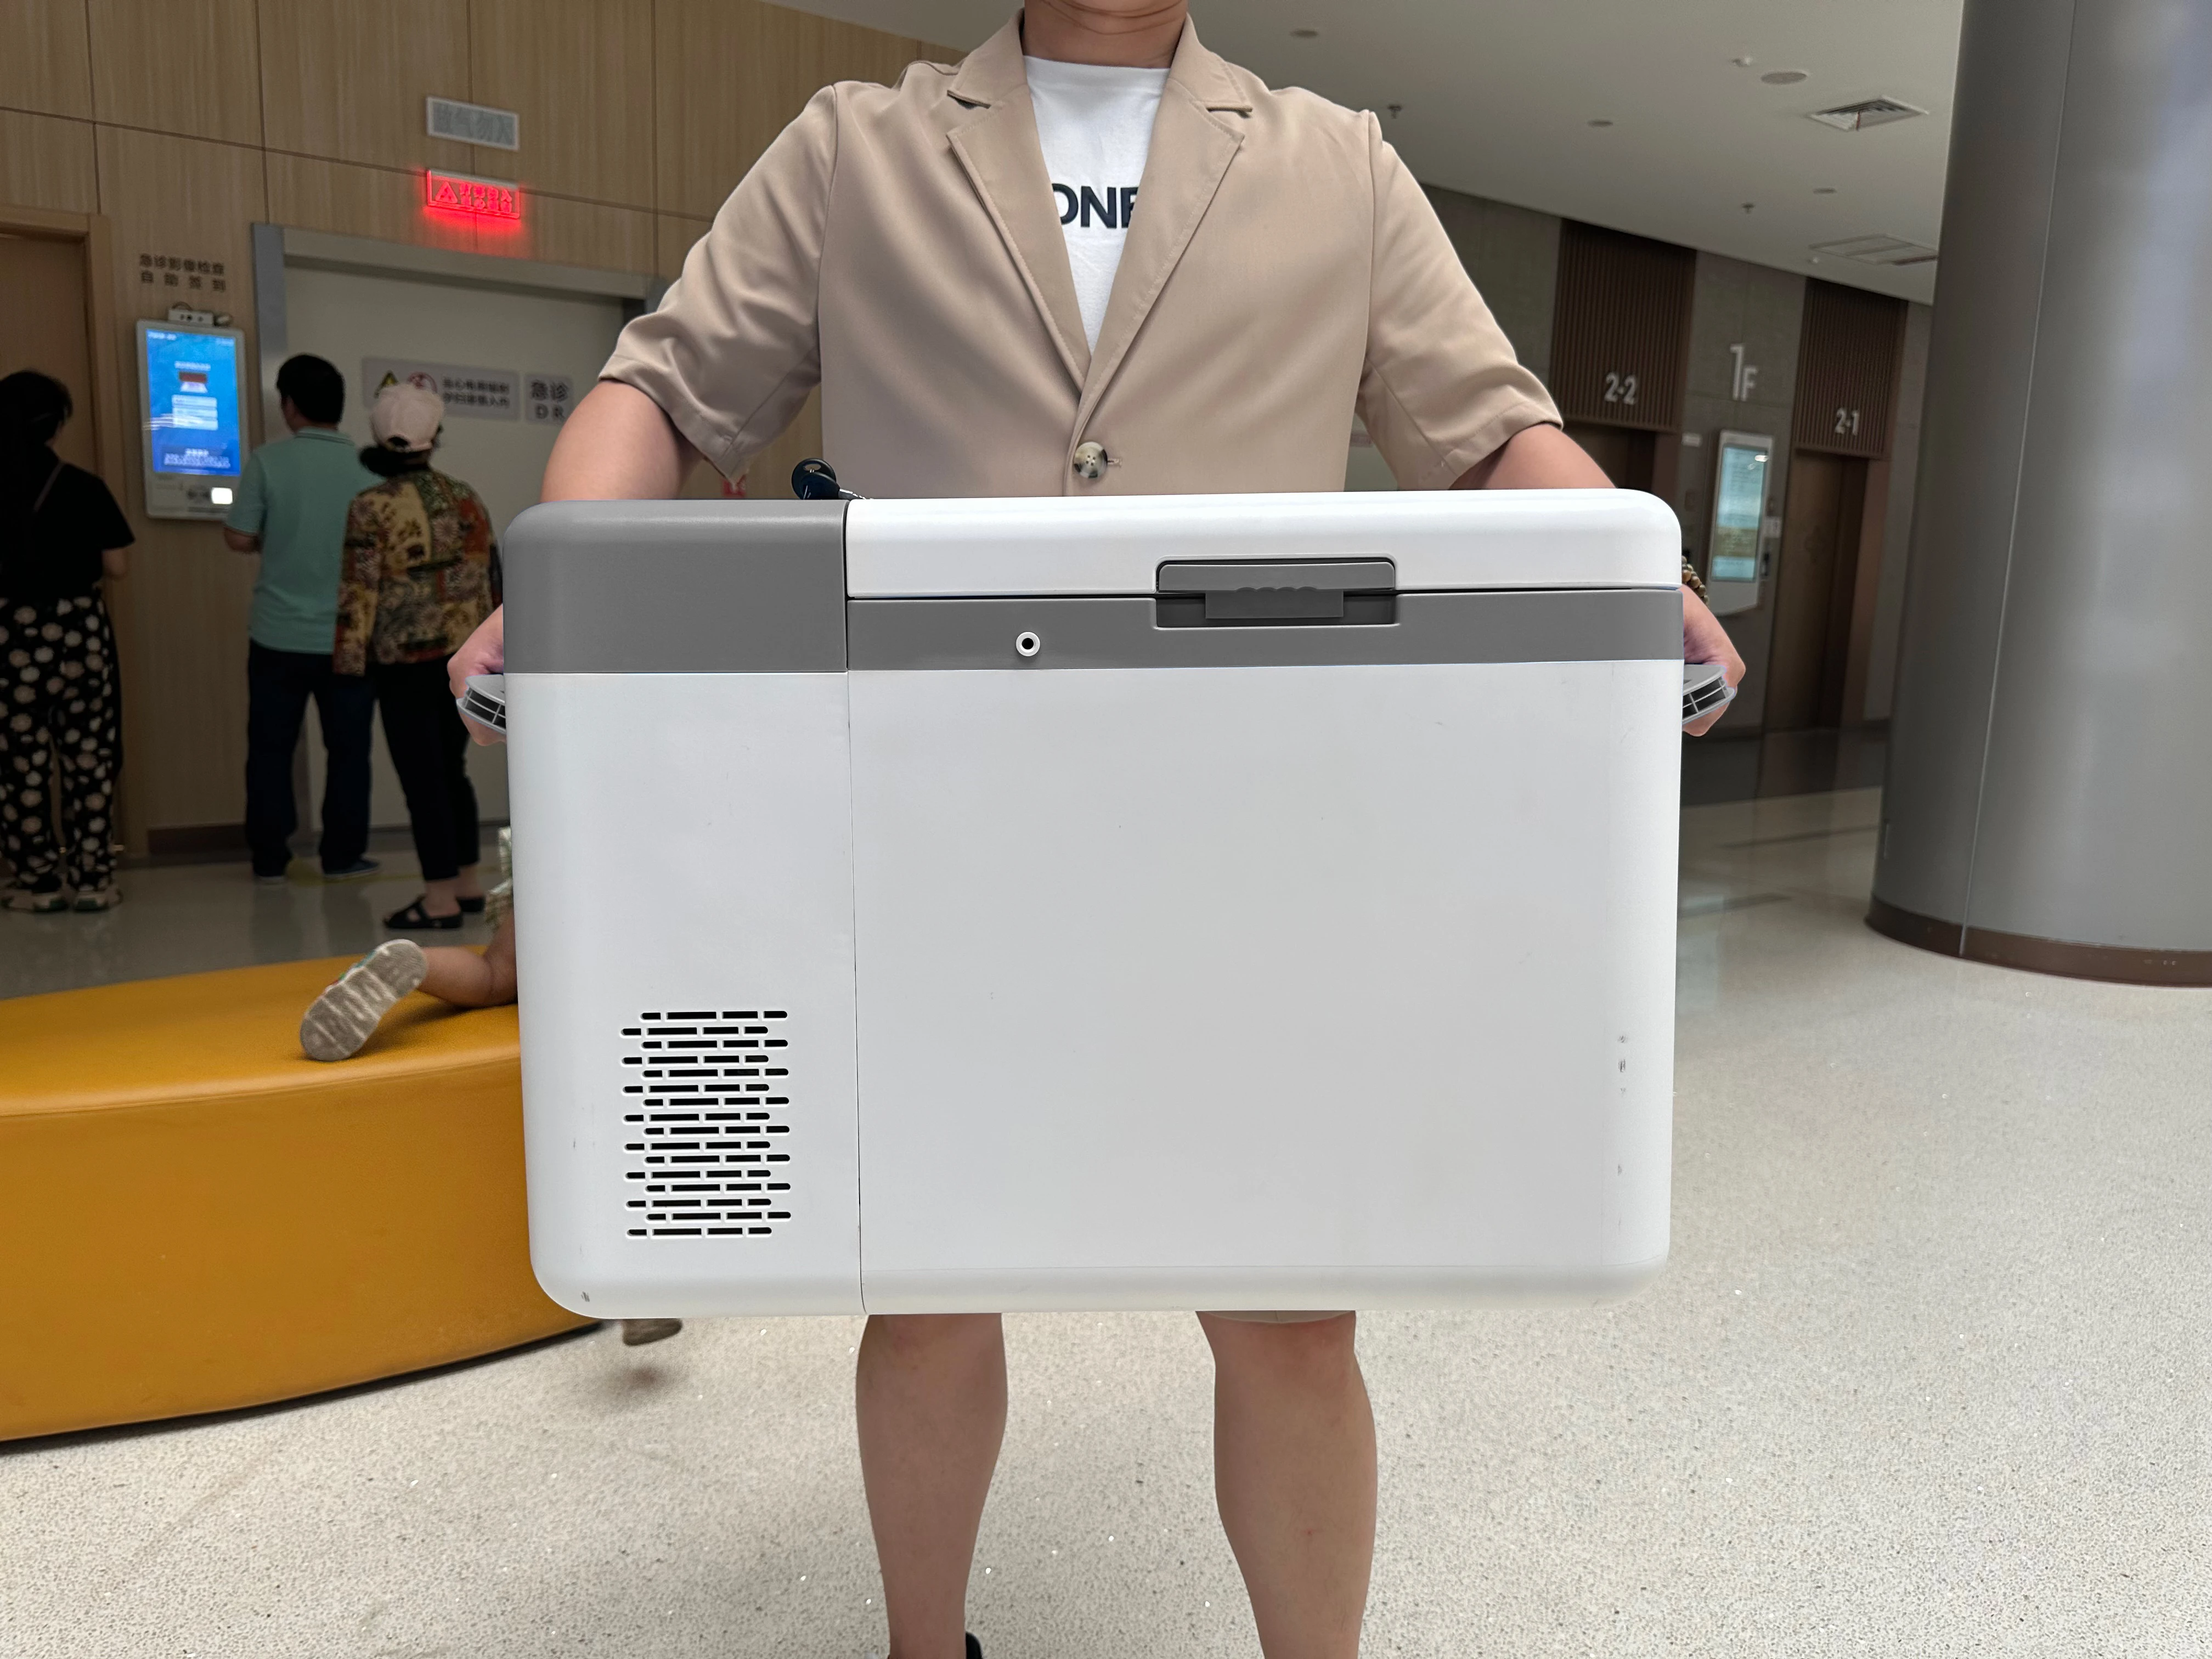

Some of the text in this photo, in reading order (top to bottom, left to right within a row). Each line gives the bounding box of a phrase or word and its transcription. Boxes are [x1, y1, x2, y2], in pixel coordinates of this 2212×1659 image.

[139, 253, 224, 275] 急诊影像检查
[140, 270, 227, 293] 自助签到
[1730, 343, 1758, 402] 1F
[531, 379, 568, 402] 急诊
[1604, 371, 1638, 405] 2-2
[1835, 407, 1860, 436] 2-1
